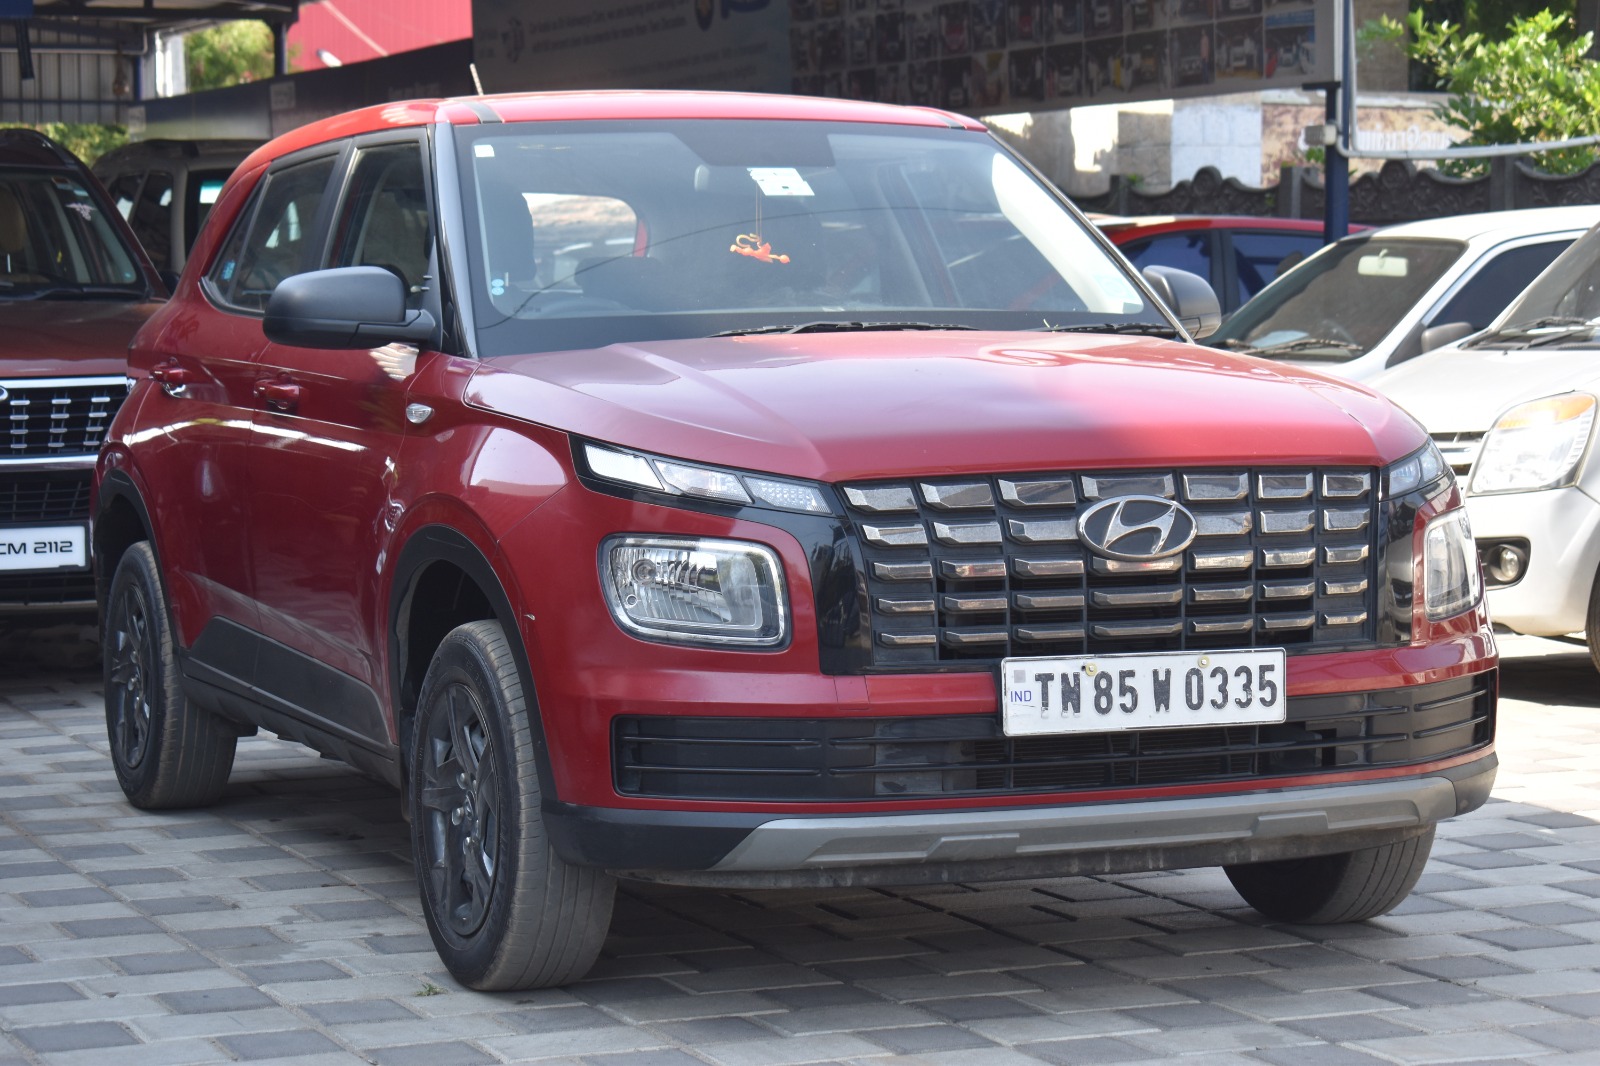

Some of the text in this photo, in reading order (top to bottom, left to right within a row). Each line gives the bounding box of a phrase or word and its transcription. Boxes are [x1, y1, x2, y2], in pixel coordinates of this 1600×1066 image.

[34, 541, 73, 554] 2112
[1010, 690, 1032, 702] IND
[1034, 664, 1278, 718] TN 85 W 0335
